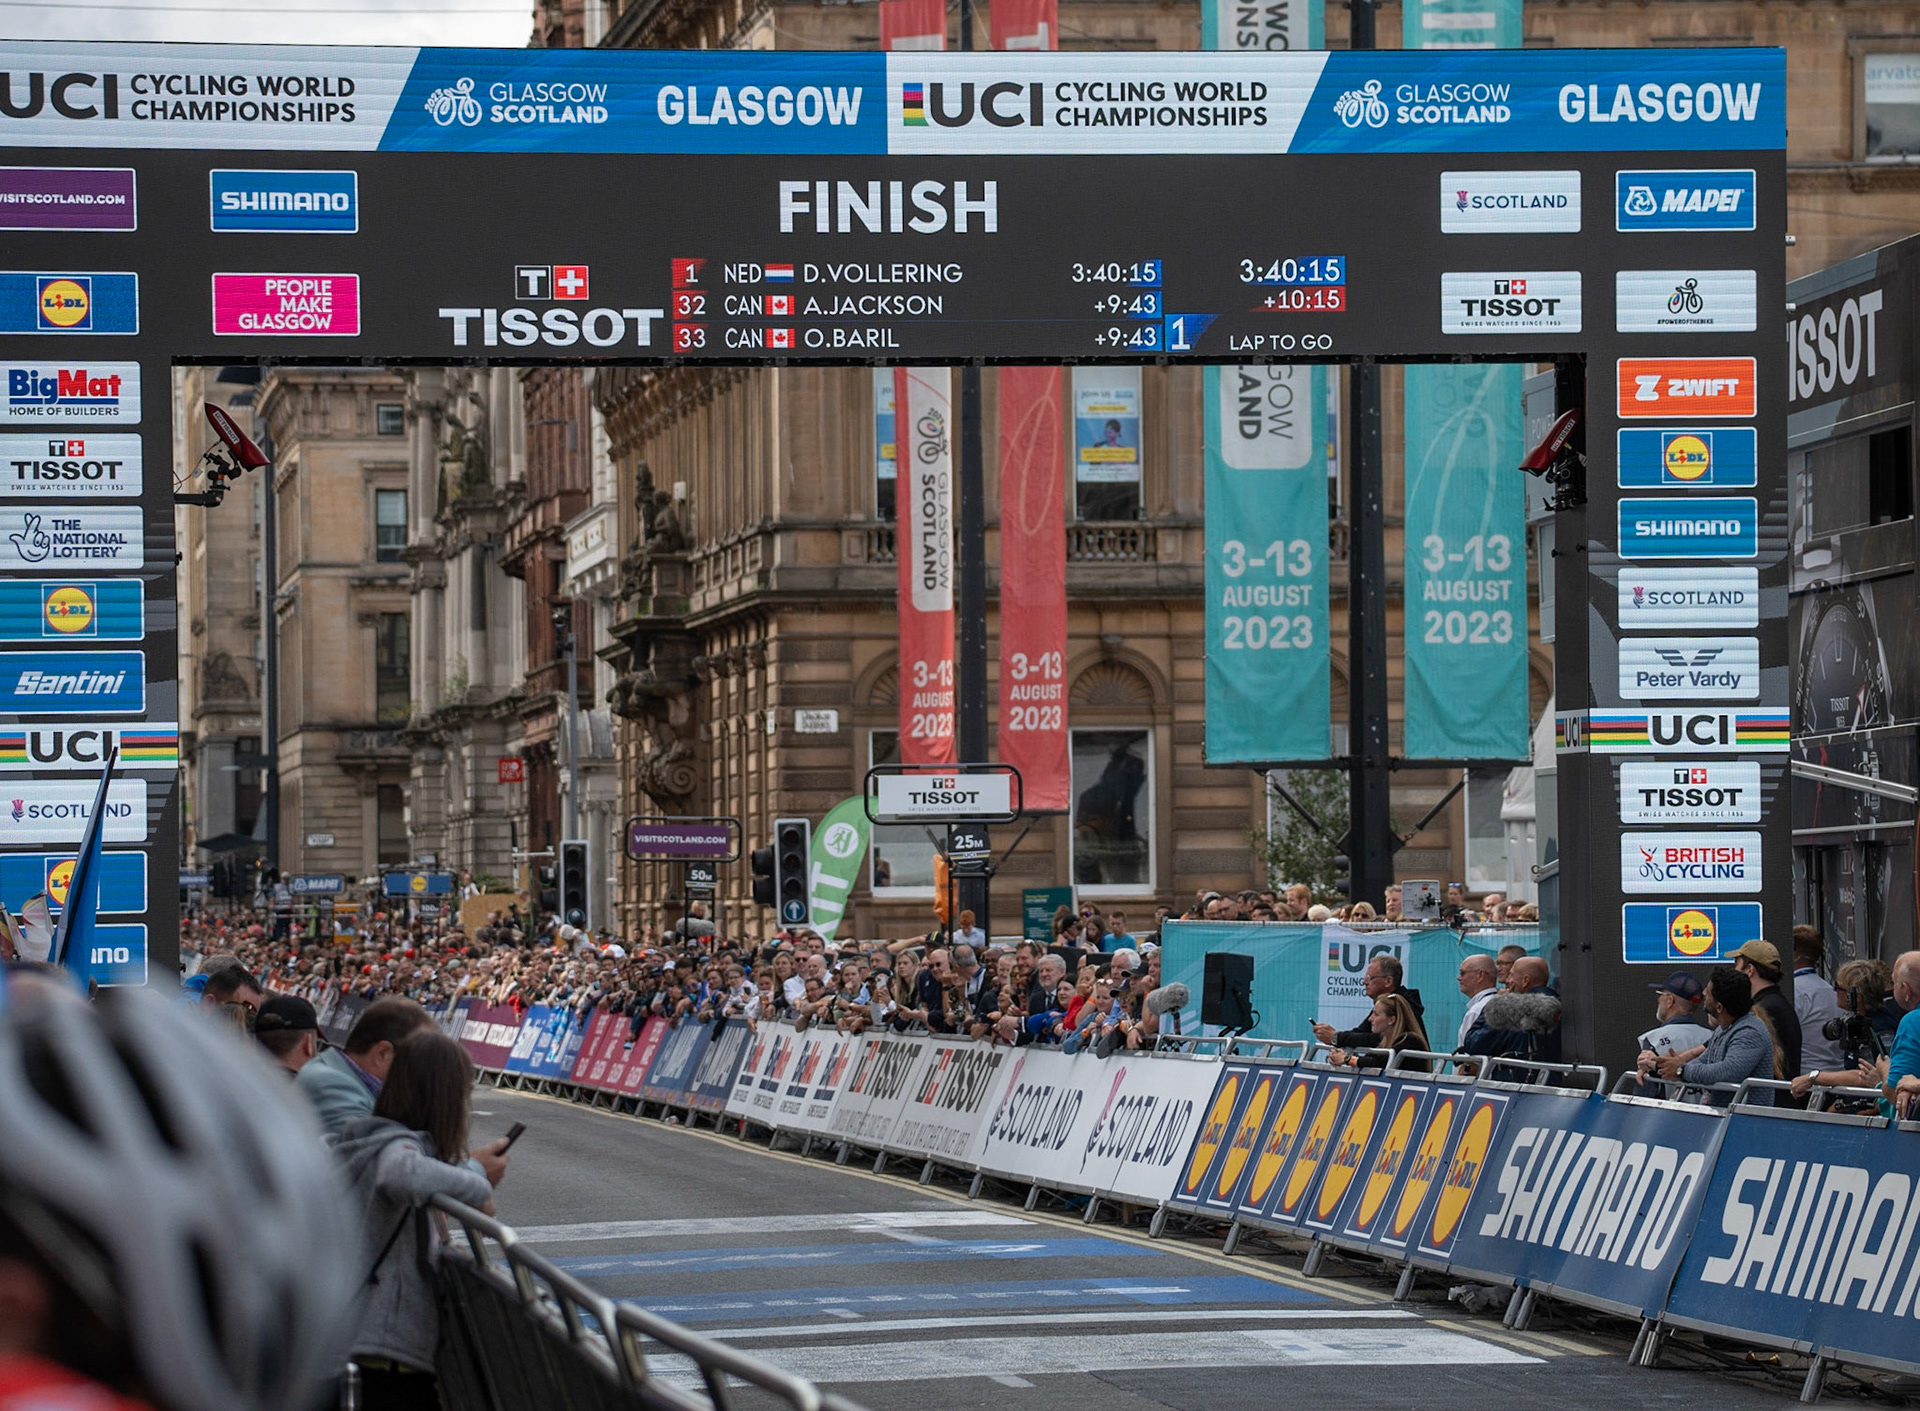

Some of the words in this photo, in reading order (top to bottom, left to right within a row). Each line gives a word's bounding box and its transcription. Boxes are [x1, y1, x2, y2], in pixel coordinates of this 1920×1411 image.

[0, 72, 118, 119] UCI
[131, 74, 248, 96] CYCLING
[260, 76, 356, 98] WORLD
[489, 82, 608, 103] GLASGOW
[1055, 82, 1166, 102] CYCLING
[1174, 81, 1268, 102] WORLD
[1396, 83, 1512, 104] GLASGOW
[131, 100, 356, 122] CHAMPIONSHIPS
[424, 88, 445, 112] 2023
[657, 85, 863, 126] GLASGOW
[930, 82, 1044, 127] UCI
[1333, 90, 1353, 115] 2023
[1558, 82, 1762, 123] GLASGOW
[489, 105, 609, 124] SCOTLAND
[1055, 107, 1268, 127] CHAMPIONSHIPS
[1396, 105, 1512, 124] SCOTLAND
[221, 191, 350, 212] SHIMANO
[779, 180, 998, 234] FINISH
[1471, 194, 1568, 210] SCOTLAND
[1661, 188, 1740, 213] MAPEI
[684, 264, 698, 283] 1
[725, 264, 762, 283] NED
[803, 264, 964, 284] D.VOLLERING
[1071, 262, 1158, 284] 3:40:15
[1239, 258, 1342, 283] 3:40:15
[265, 279, 332, 297] PEOPLE
[280, 296, 332, 314] MAKE
[678, 296, 706, 315] 32
[725, 296, 763, 316] CAN
[803, 296, 944, 316] A.JACKSON
[1094, 295, 1158, 315] +9:43
[1263, 290, 1341, 309] +10:15
[1461, 298, 1561, 317] TISSOT
[238, 313, 332, 331] GLASGOW
[438, 307, 666, 348] TISSOT
[678, 329, 706, 349] 33
[725, 329, 763, 349] CAN
[804, 329, 900, 349] O.BARIL
[1094, 328, 1158, 348] +9:43
[1170, 316, 1191, 351] 1
[1229, 335, 1264, 351] LAP
[1268, 335, 1296, 350] TO
[1300, 334, 1333, 350] GO
[9, 369, 122, 404] BigMat
[1668, 378, 1739, 397] ZWIFT
[9, 406, 44, 416] HOME
[46, 406, 62, 416] OF
[65, 406, 119, 416] BUILDERS
[10, 460, 123, 480] TISSOT
[52, 519, 81, 530] THE
[921, 473, 937, 591] SCOTLAND
[937, 471, 950, 590] GLASGOW
[1635, 519, 1741, 536] SHIMANO
[53, 533, 128, 544] NATIONAL
[53, 546, 121, 558] LOTTERY
[1222, 538, 1313, 578] 3-13
[1423, 534, 1512, 573] 3-13
[1222, 584, 1313, 607] AUGUST
[1423, 579, 1512, 602] AUGUST
[1648, 591, 1744, 605] SCOTLAND
[1223, 614, 1314, 650] 2023
[1423, 609, 1514, 644] 2023
[913, 659, 954, 688] 3-13
[1011, 651, 1063, 680] 3-13
[14, 670, 126, 694] Santini
[1637, 671, 1686, 688] Peter
[1689, 671, 1742, 689] Vardy
[912, 690, 954, 708] AUGUST
[1010, 682, 1063, 701] AUGUST
[912, 713, 953, 738] 2023
[1009, 704, 1062, 731] 2023
[1565, 717, 1580, 747] UCI
[1652, 714, 1728, 746] UCI
[30, 731, 113, 763] UCI
[908, 792, 980, 804] TISSOT
[1638, 788, 1743, 807] TISSOT
[28, 804, 132, 818] SCOTLND
[634, 834, 727, 844] VISITSCOTLAND.COM
[954, 834, 984, 849] 25M
[1665, 847, 1744, 863] BRITISH
[1665, 864, 1744, 879] CYCLING
[1327, 976, 1364, 986] CYCLING
[1659, 1037, 1671, 1046] 35
[863, 1041, 923, 1100] TISSOT
[935, 1049, 1004, 1114] TISSOT
[999, 1082, 1084, 1152] SCOTLAND
[1099, 1094, 1194, 1168] SCOTLAND
[1479, 1127, 1704, 1271] SHIMANO
[1700, 1156, 1920, 1319] SHIMAN
